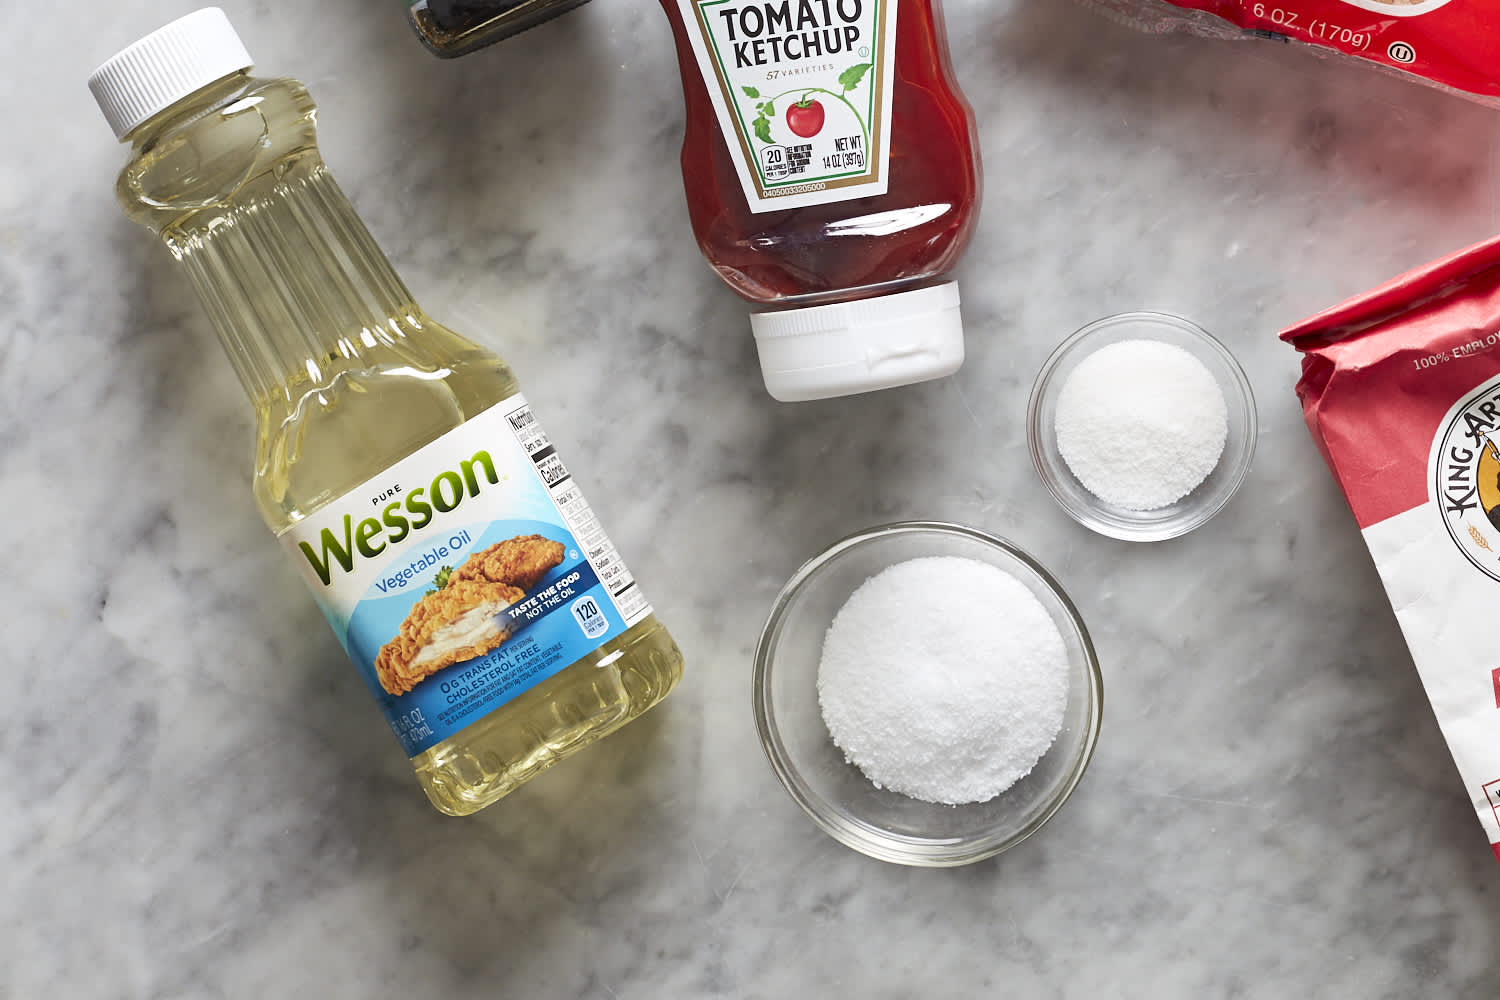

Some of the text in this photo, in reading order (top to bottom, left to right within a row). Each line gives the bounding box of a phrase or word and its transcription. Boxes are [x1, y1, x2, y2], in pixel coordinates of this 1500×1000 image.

[1270, 8, 1300, 31] OZ.
[1308, 18, 1371, 51] (170g)
[733, 25, 860, 69] KETCHUP
[766, 63, 834, 80] 57 VARIETIES
[767, 150, 781, 163] 20
[1413, 352, 1451, 371] 100%
[372, 483, 402, 506] PURE
[1446, 447, 1477, 518] KING
[298, 449, 500, 587] Wesson
[375, 529, 472, 594] Vegetable Oil
[508, 571, 580, 618] TASTE THE FOOD
[576, 601, 597, 621] 120
[526, 606, 543, 620] NOT
[446, 661, 515, 705] CHOLESTEROL
[515, 644, 541, 664] FREE
[457, 662, 491, 684] TRANS
